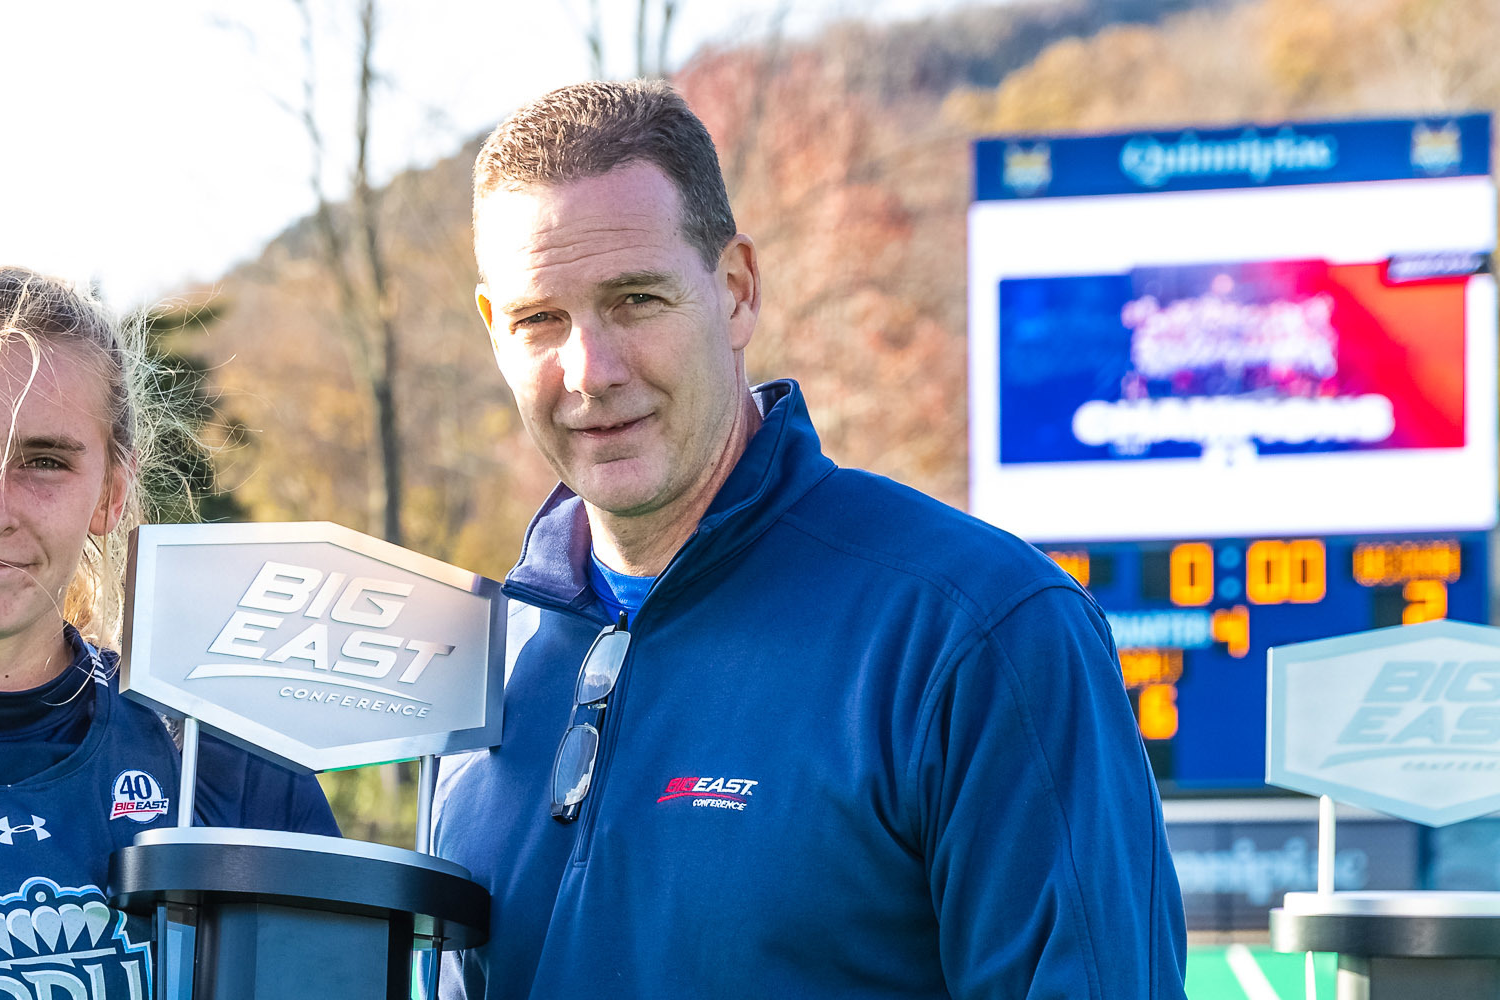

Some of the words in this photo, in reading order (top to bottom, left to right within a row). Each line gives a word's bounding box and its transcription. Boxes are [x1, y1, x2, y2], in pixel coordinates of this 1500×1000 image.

[237, 561, 415, 629] BIG
[207, 611, 457, 684] EAST
[1364, 661, 1500, 703] BIG
[279, 686, 432, 718] CONFERENCE
[1336, 706, 1500, 744] EAS
[120, 775, 152, 800] 40
[692, 798, 748, 812] CONFERENCE
